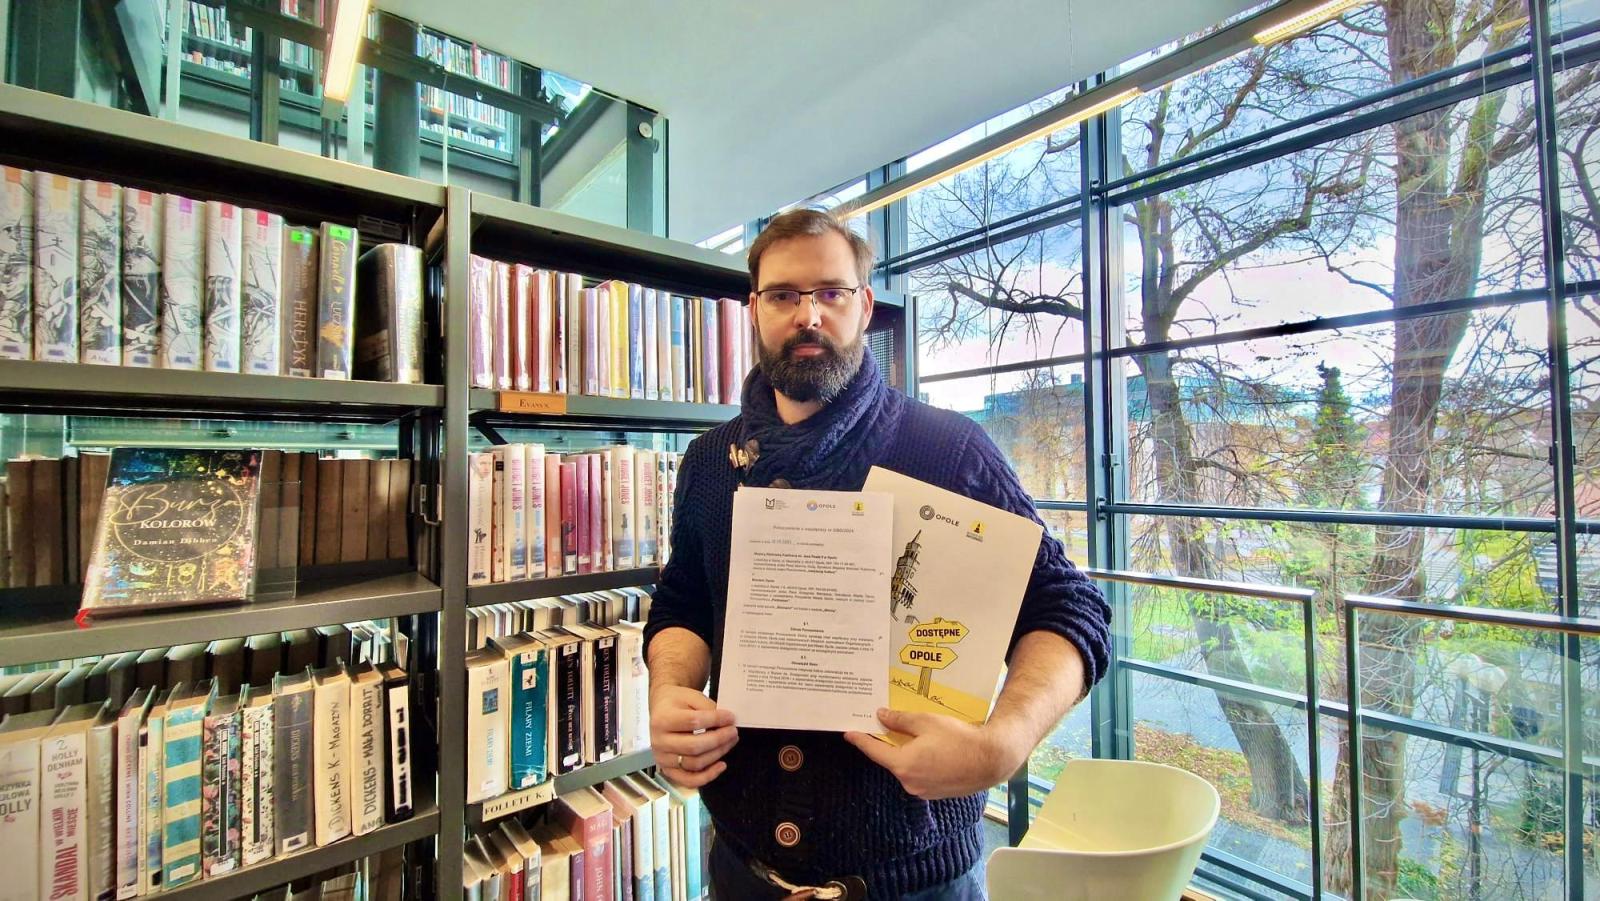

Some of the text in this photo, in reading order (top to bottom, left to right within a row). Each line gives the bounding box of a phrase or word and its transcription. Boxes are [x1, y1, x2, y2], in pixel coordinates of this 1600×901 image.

[289, 299, 310, 366] HERETYK
[620, 485, 630, 504] JONES
[643, 487, 652, 506] JONES
[936, 513, 961, 528] OPOLE
[133, 539, 175, 547] Damian
[916, 628, 961, 639] DOSTĘPNE
[909, 650, 943, 662] OPOLE
[362, 688, 374, 728] DORRIT
[328, 701, 342, 750] MAGAZYN
[524, 701, 533, 756] FILARY ZIEMI
[363, 729, 374, 758] MAŁA
[47, 758, 83, 773] DENHAM
[51, 750, 80, 762] HOLLY
[363, 766, 377, 815] DICKENS
[328, 772, 345, 833] DICKENS
[485, 795, 530, 815] FOLLETT
[49, 843, 78, 901] SKANDAL
